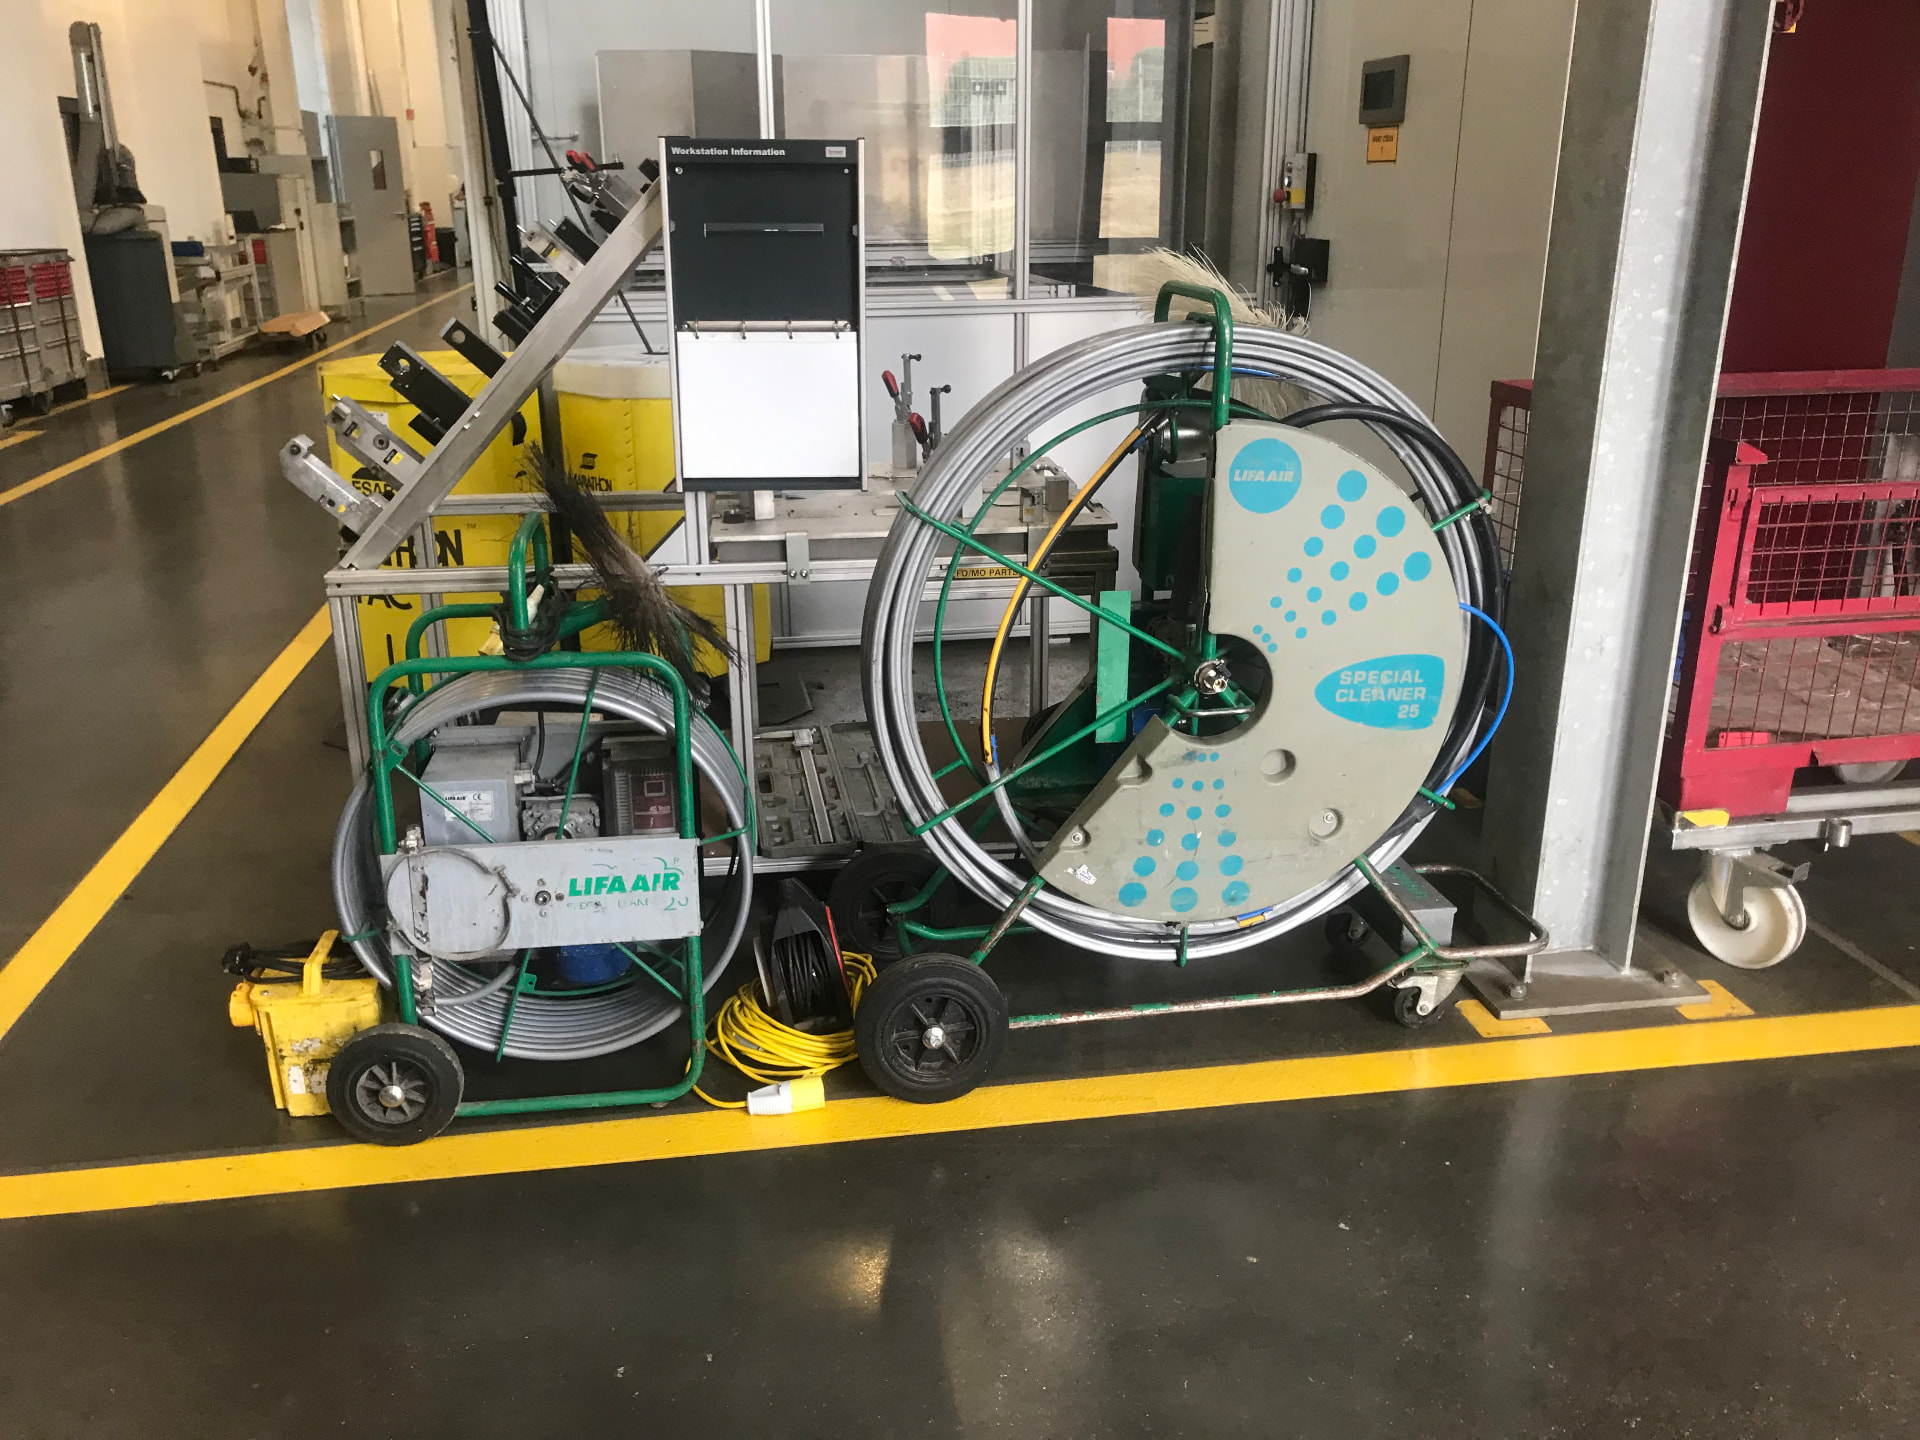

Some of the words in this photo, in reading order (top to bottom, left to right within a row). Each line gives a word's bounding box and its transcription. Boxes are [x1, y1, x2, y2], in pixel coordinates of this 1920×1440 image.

[671, 146, 729, 155] Workstation
[731, 147, 786, 156] Information
[1233, 469, 1265, 482] LIFA
[1266, 470, 1295, 482] AIR
[989, 569, 1018, 577] PARTS
[1339, 670, 1424, 685] SPECIAL
[1335, 686, 1427, 703] CLEANER
[1397, 704, 1420, 719] 25
[568, 875, 627, 897] LIFA
[631, 872, 680, 892] AIR
